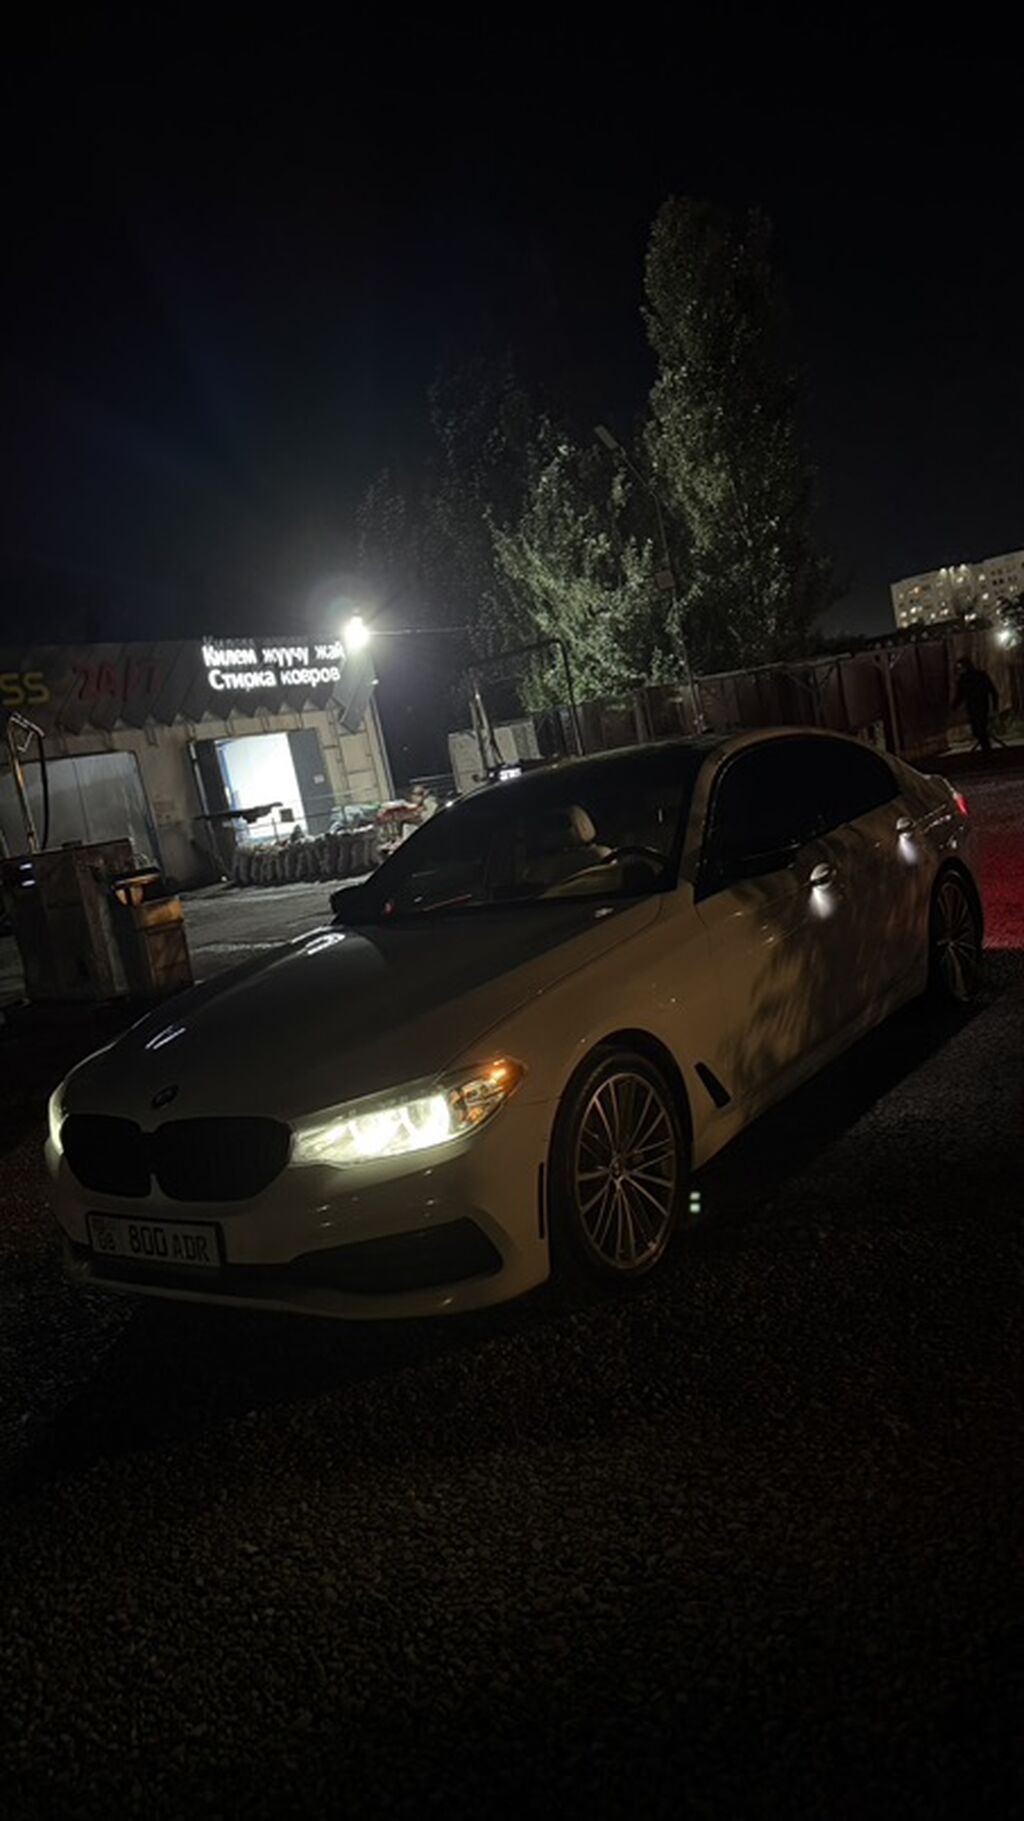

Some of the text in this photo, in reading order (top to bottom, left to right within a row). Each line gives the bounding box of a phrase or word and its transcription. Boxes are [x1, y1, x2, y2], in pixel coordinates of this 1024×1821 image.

[202, 645, 258, 667] Килем
[208, 666, 341, 691] Стирка ковров
